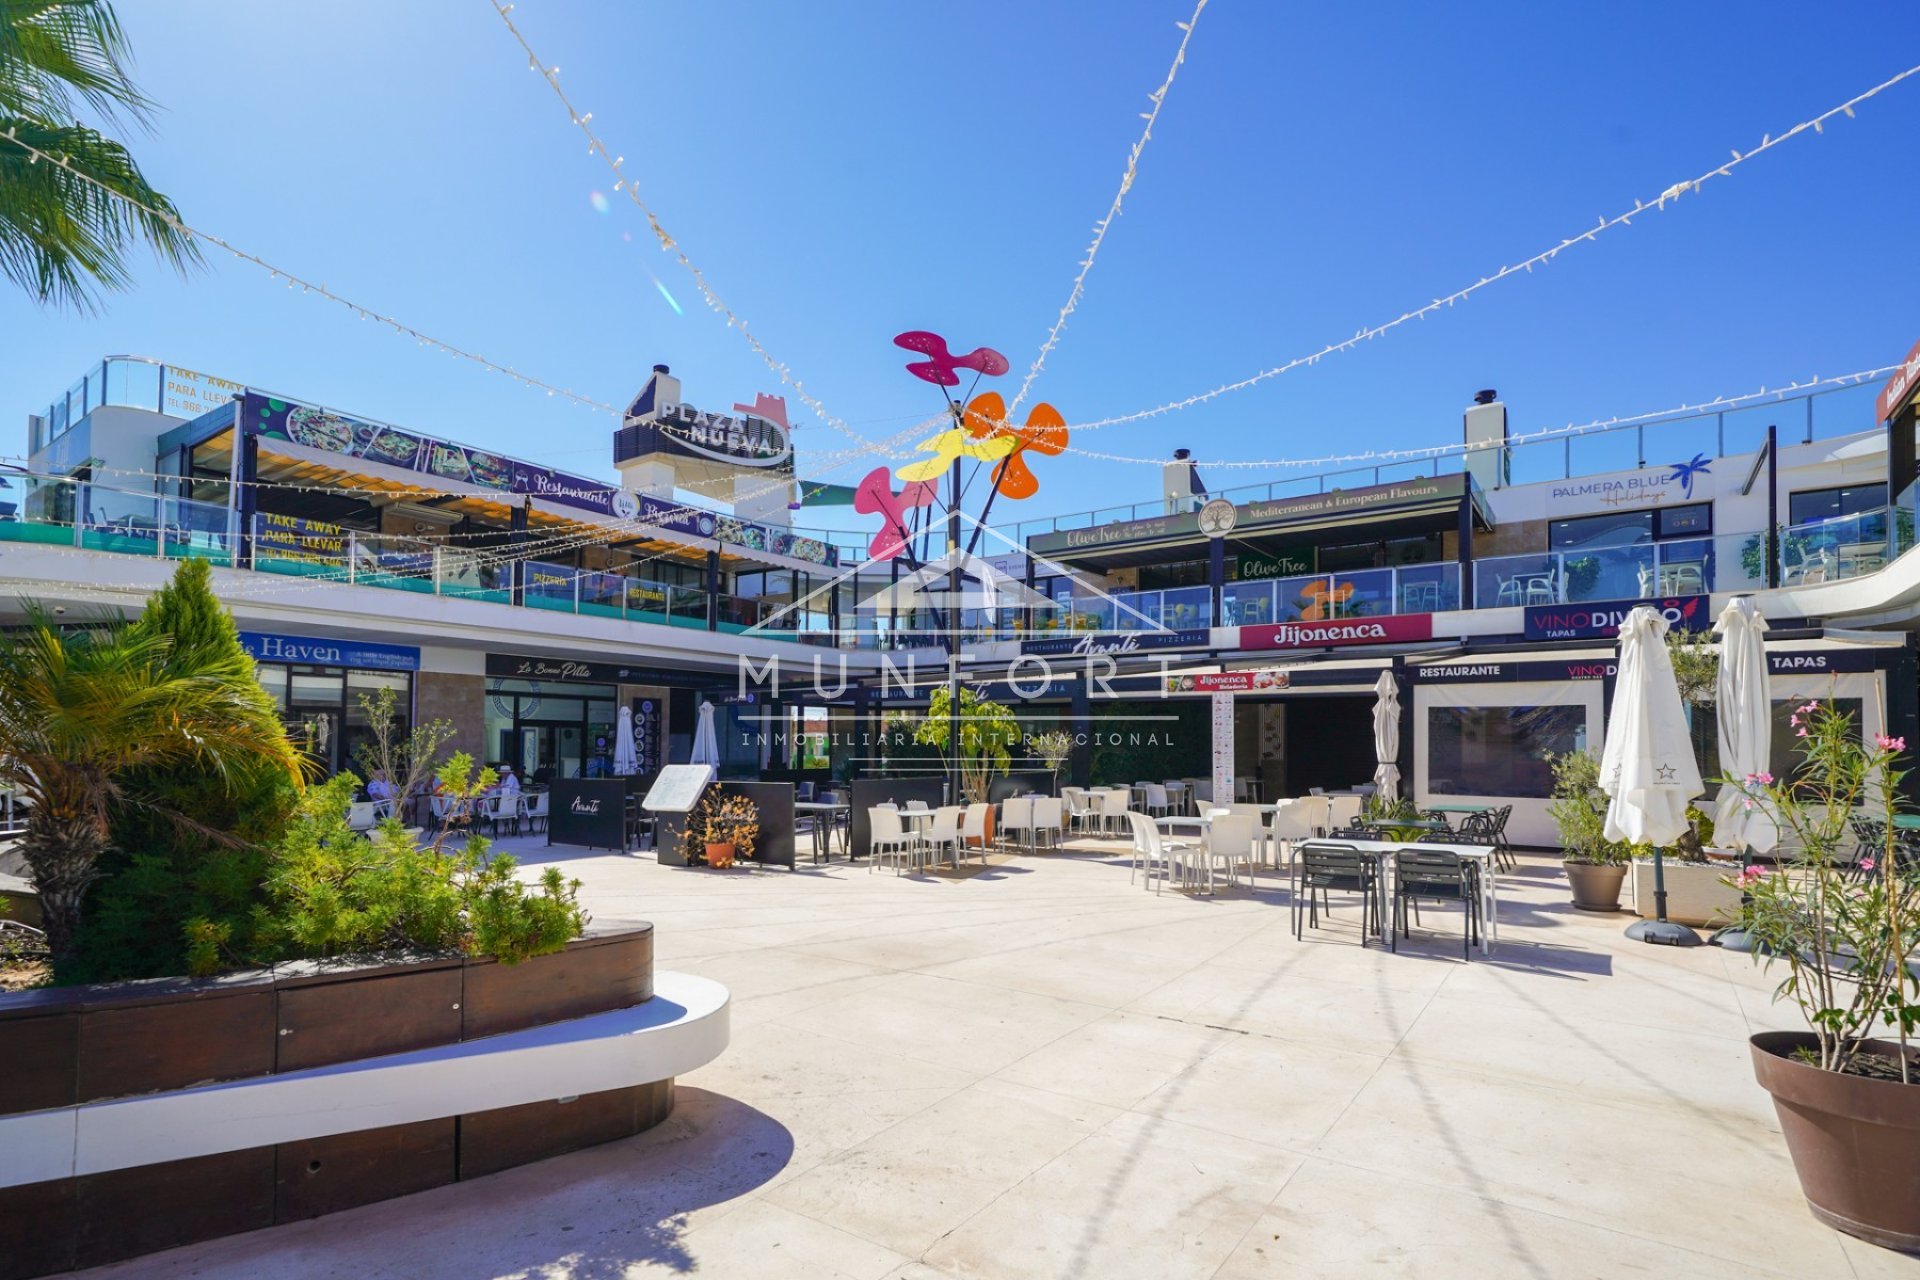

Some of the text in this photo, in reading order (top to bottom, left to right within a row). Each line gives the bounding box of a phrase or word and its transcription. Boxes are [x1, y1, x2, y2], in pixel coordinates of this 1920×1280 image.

[168, 365, 242, 392] TAKE AWAY
[167, 382, 233, 404] PARA LLEV
[661, 401, 745, 433] PLAZA
[691, 425, 772, 455] NUEVA
[533, 473, 609, 506] Restaurante
[1553, 474, 1670, 499] PALMERA BLUE
[1600, 489, 1666, 506] Holidays
[1250, 485, 1439, 519] Mediterranean & European Flavours
[265, 512, 342, 536] TAKE AWAY
[264, 530, 342, 552] PARA LLEVAR
[1243, 557, 1307, 577] Olive Tree
[1158, 635, 1202, 643] PIZZERIA
[1273, 623, 1387, 646] Jijonenca
[1546, 629, 1576, 638] TAPAS
[260, 638, 341, 661] Haven
[1420, 665, 1500, 677] RESTAURANTE
[1773, 656, 1827, 668] TAPAS
[1199, 675, 1248, 687] Jijonenca
